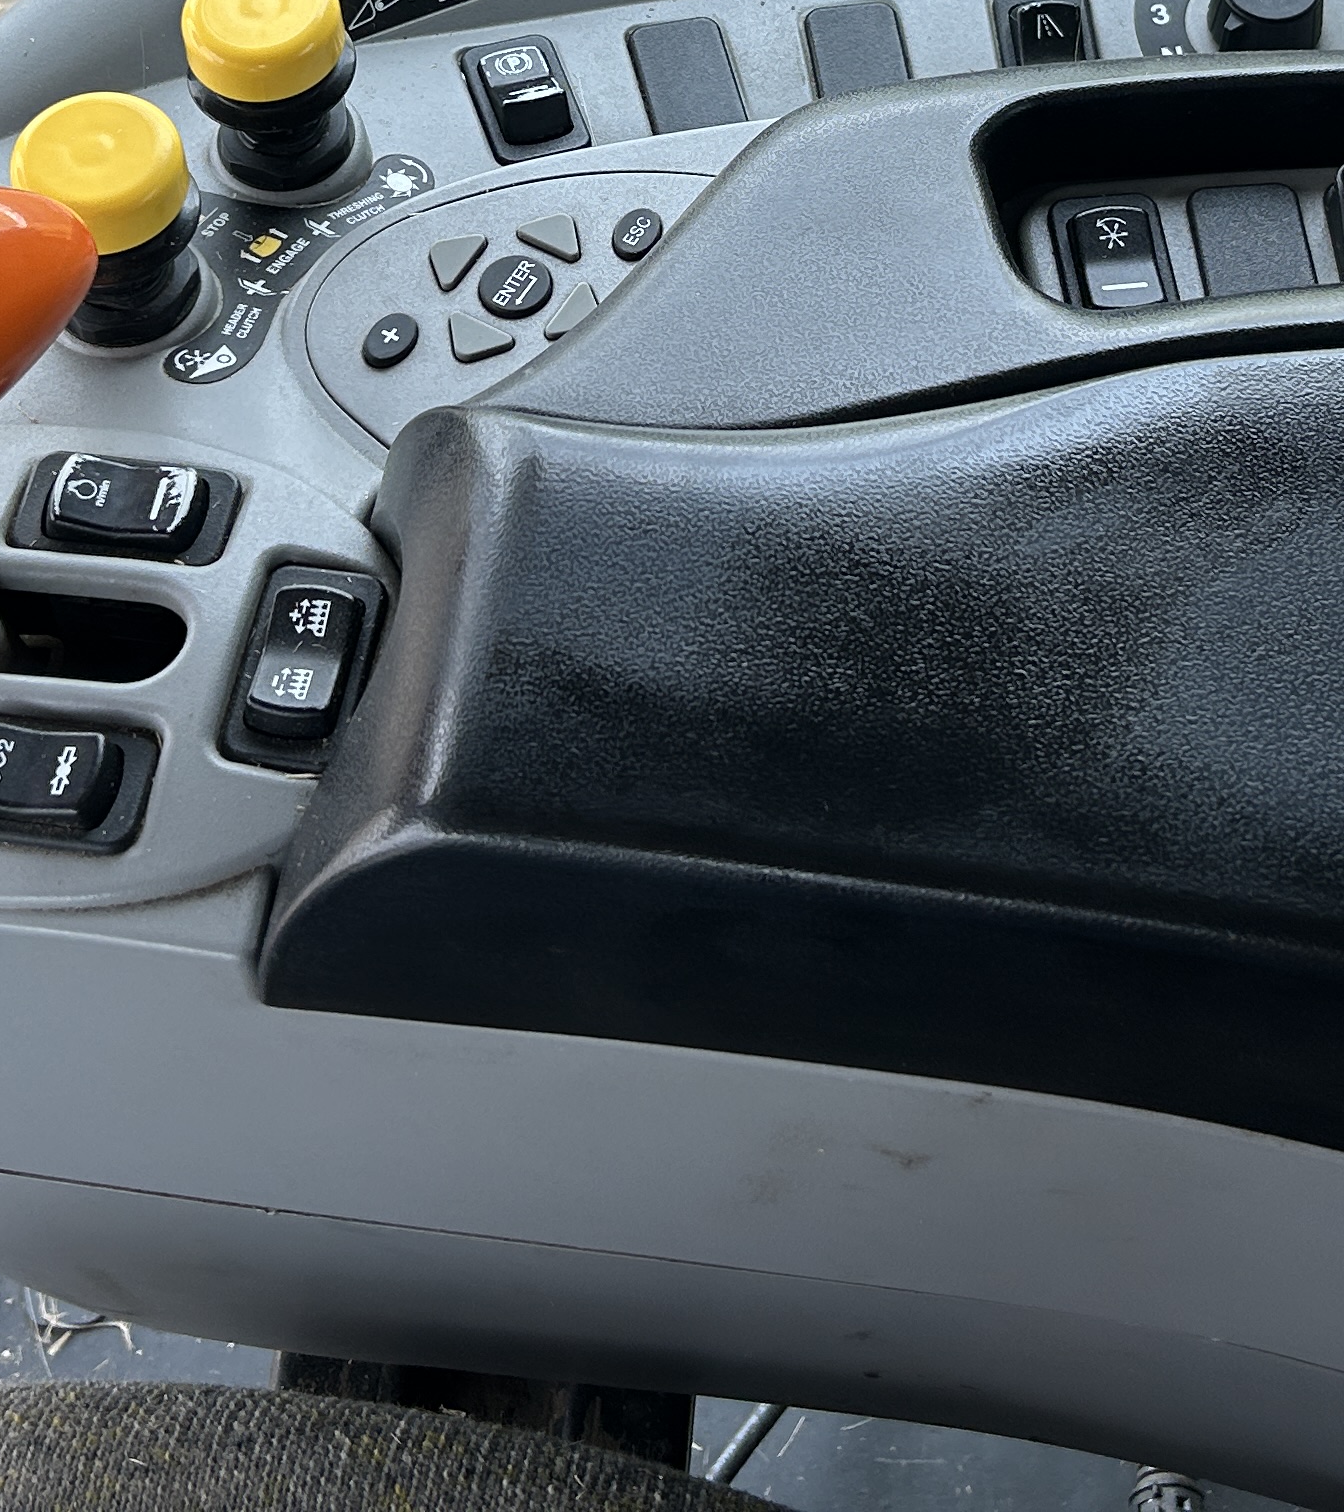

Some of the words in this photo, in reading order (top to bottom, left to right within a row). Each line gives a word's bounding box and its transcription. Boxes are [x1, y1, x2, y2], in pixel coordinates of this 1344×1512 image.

[1150, 3, 1170, 25] 3
[326, 192, 385, 221] THRESHING
[346, 204, 386, 225] CLUTCH
[201, 212, 231, 238] STOP
[622, 216, 652, 246] ESC
[265, 237, 311, 275] ENGAGE
[492, 260, 536, 307] ENTER
[221, 303, 249, 336] HEADER
[236, 307, 263, 339] CLUTCH
